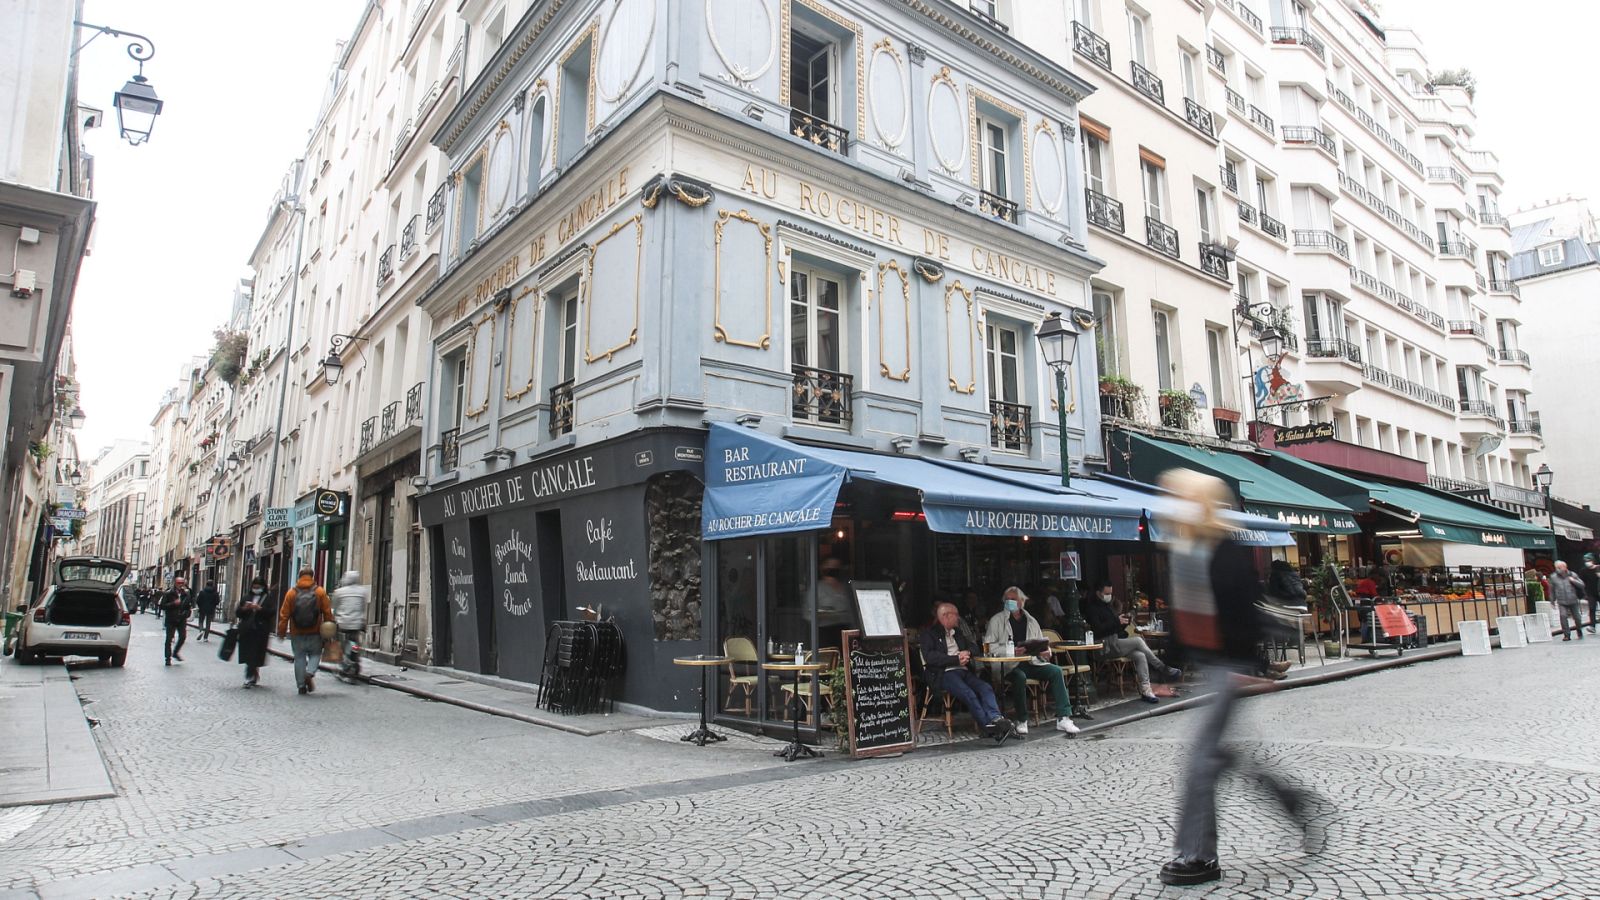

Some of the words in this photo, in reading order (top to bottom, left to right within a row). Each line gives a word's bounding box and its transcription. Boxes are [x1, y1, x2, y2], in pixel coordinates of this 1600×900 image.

[741, 164, 779, 200] AU
[799, 182, 903, 245] ROCHER
[923, 228, 950, 261] DE
[972, 246, 1056, 296] CANCALE
[453, 295, 467, 322] AU
[476, 255, 519, 307] ROCHER
[530, 234, 545, 266] DE
[558, 166, 629, 244] CANCALE
[725, 447, 749, 463] BAR
[725, 458, 807, 482] RESTAURANT
[444, 493, 456, 518] AU
[461, 482, 502, 514] ROCHER
[506, 476, 525, 504] DE
[531, 457, 596, 498] CANCALE
[708, 519, 718, 532] AU
[719, 515, 752, 531] ROCHER
[754, 513, 767, 527] DE
[768, 508, 820, 525] CANCALE
[965, 510, 985, 528] AU
[988, 511, 1039, 530] ROCHER
[1042, 514, 1059, 531] DE
[1061, 515, 1113, 534] CANCALE
[494, 528, 533, 566] Breakfast
[586, 517, 614, 552] Café
[505, 562, 528, 585] Lunch
[576, 558, 638, 582] Restaurant
[503, 589, 532, 616] Dinner
